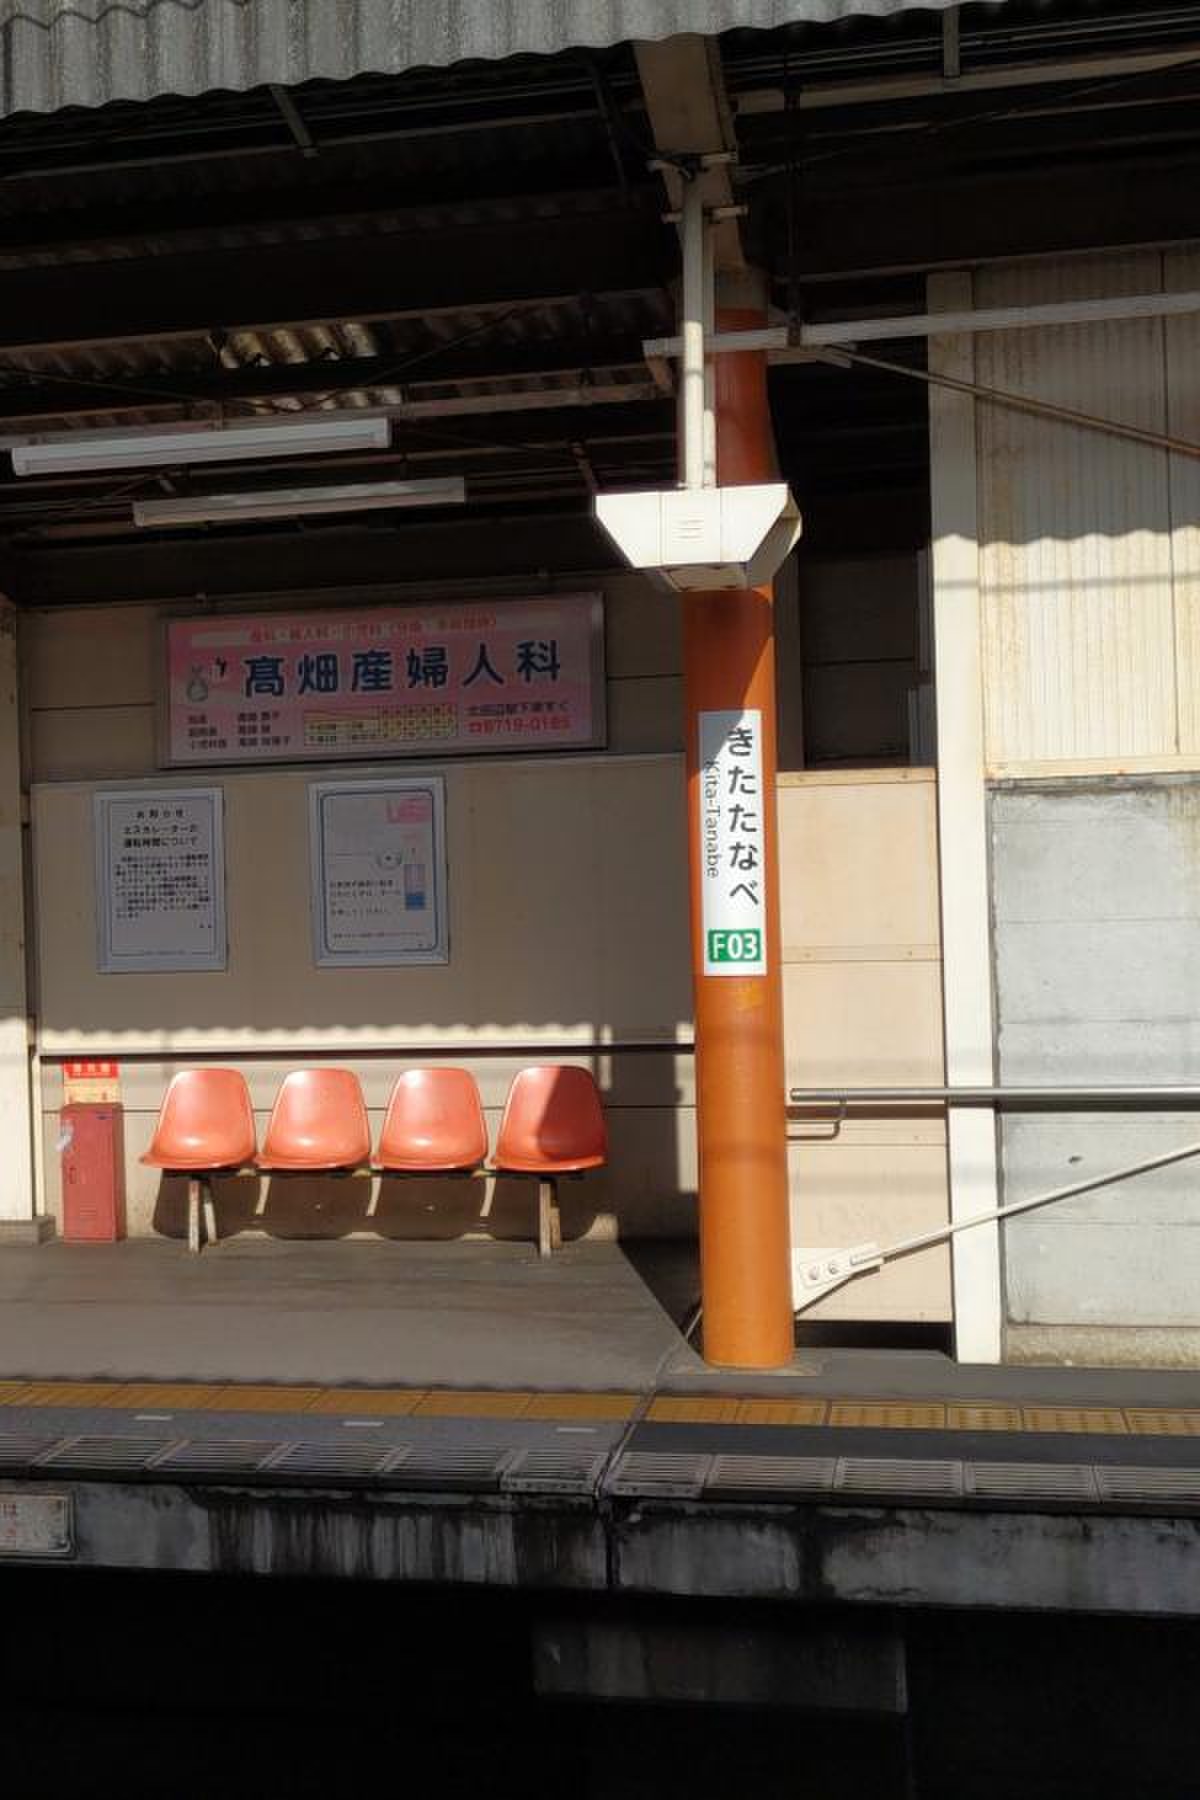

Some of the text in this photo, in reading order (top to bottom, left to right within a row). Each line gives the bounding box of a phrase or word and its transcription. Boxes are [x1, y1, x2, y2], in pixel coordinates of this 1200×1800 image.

[704, 760, 722, 879] Kita-Tanabe
[727, 727, 759, 905] きたたなべ
[712, 932, 758, 960] F03
